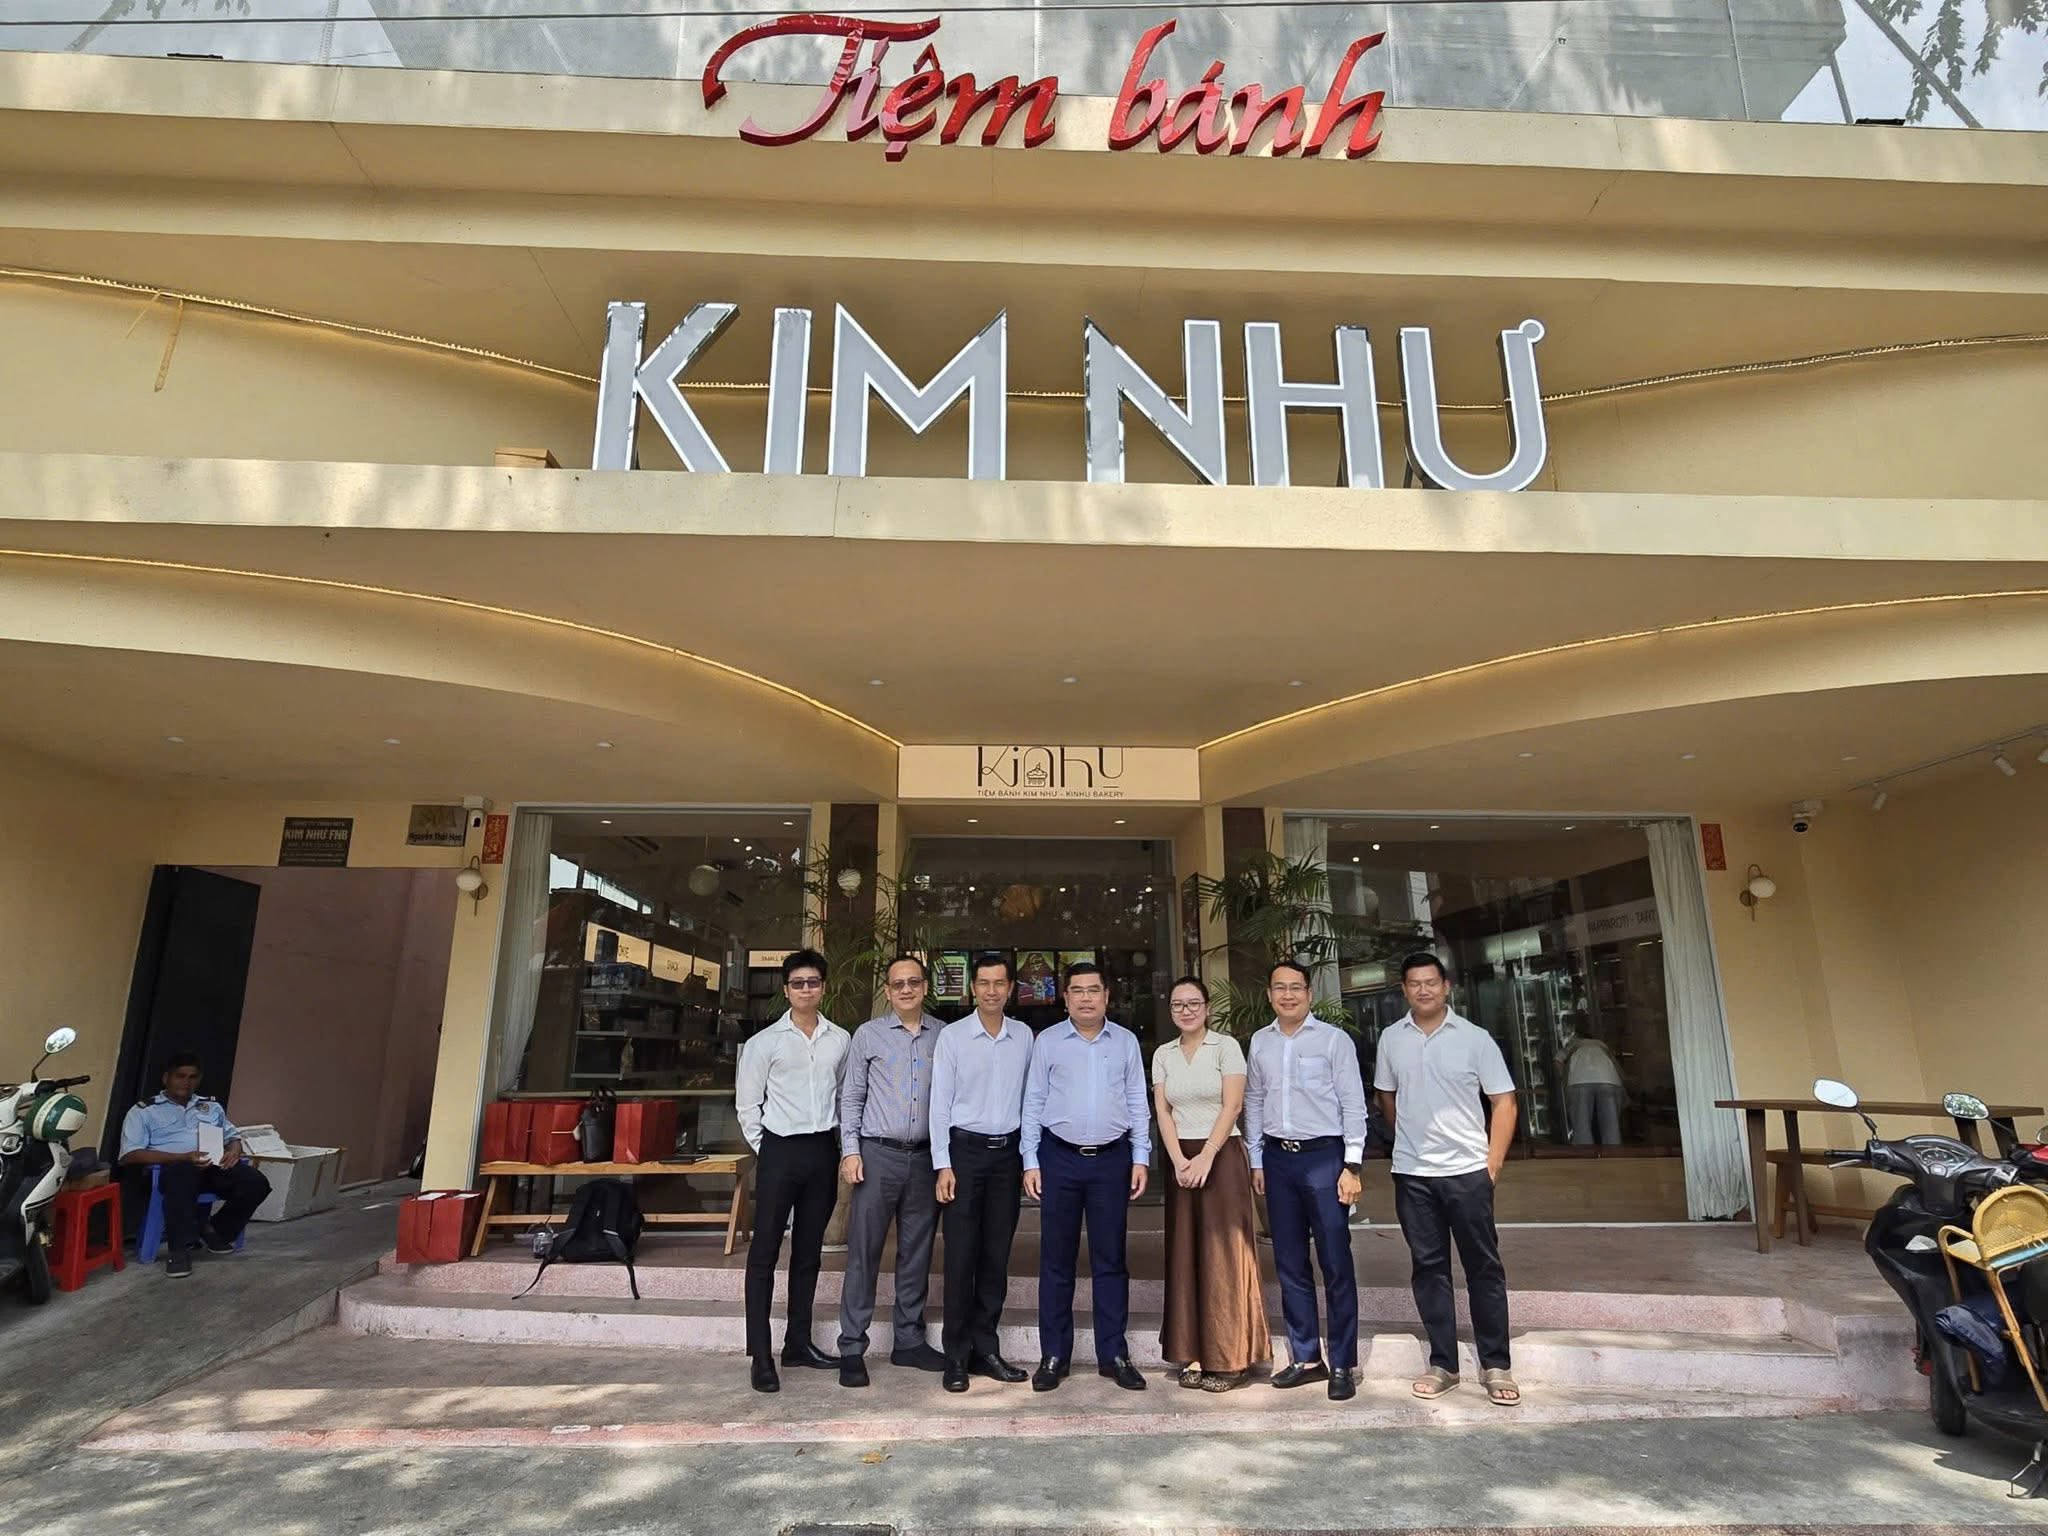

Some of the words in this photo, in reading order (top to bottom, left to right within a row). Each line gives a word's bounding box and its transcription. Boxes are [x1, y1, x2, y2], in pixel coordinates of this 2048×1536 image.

[702, 14, 1058, 162] Tiệm
[1108, 18, 1386, 159] bánh
[592, 301, 1007, 480] KIM
[1084, 316, 1547, 491] NHƯ
[285, 829, 304, 840] KIM
[329, 829, 348, 840] FNB
